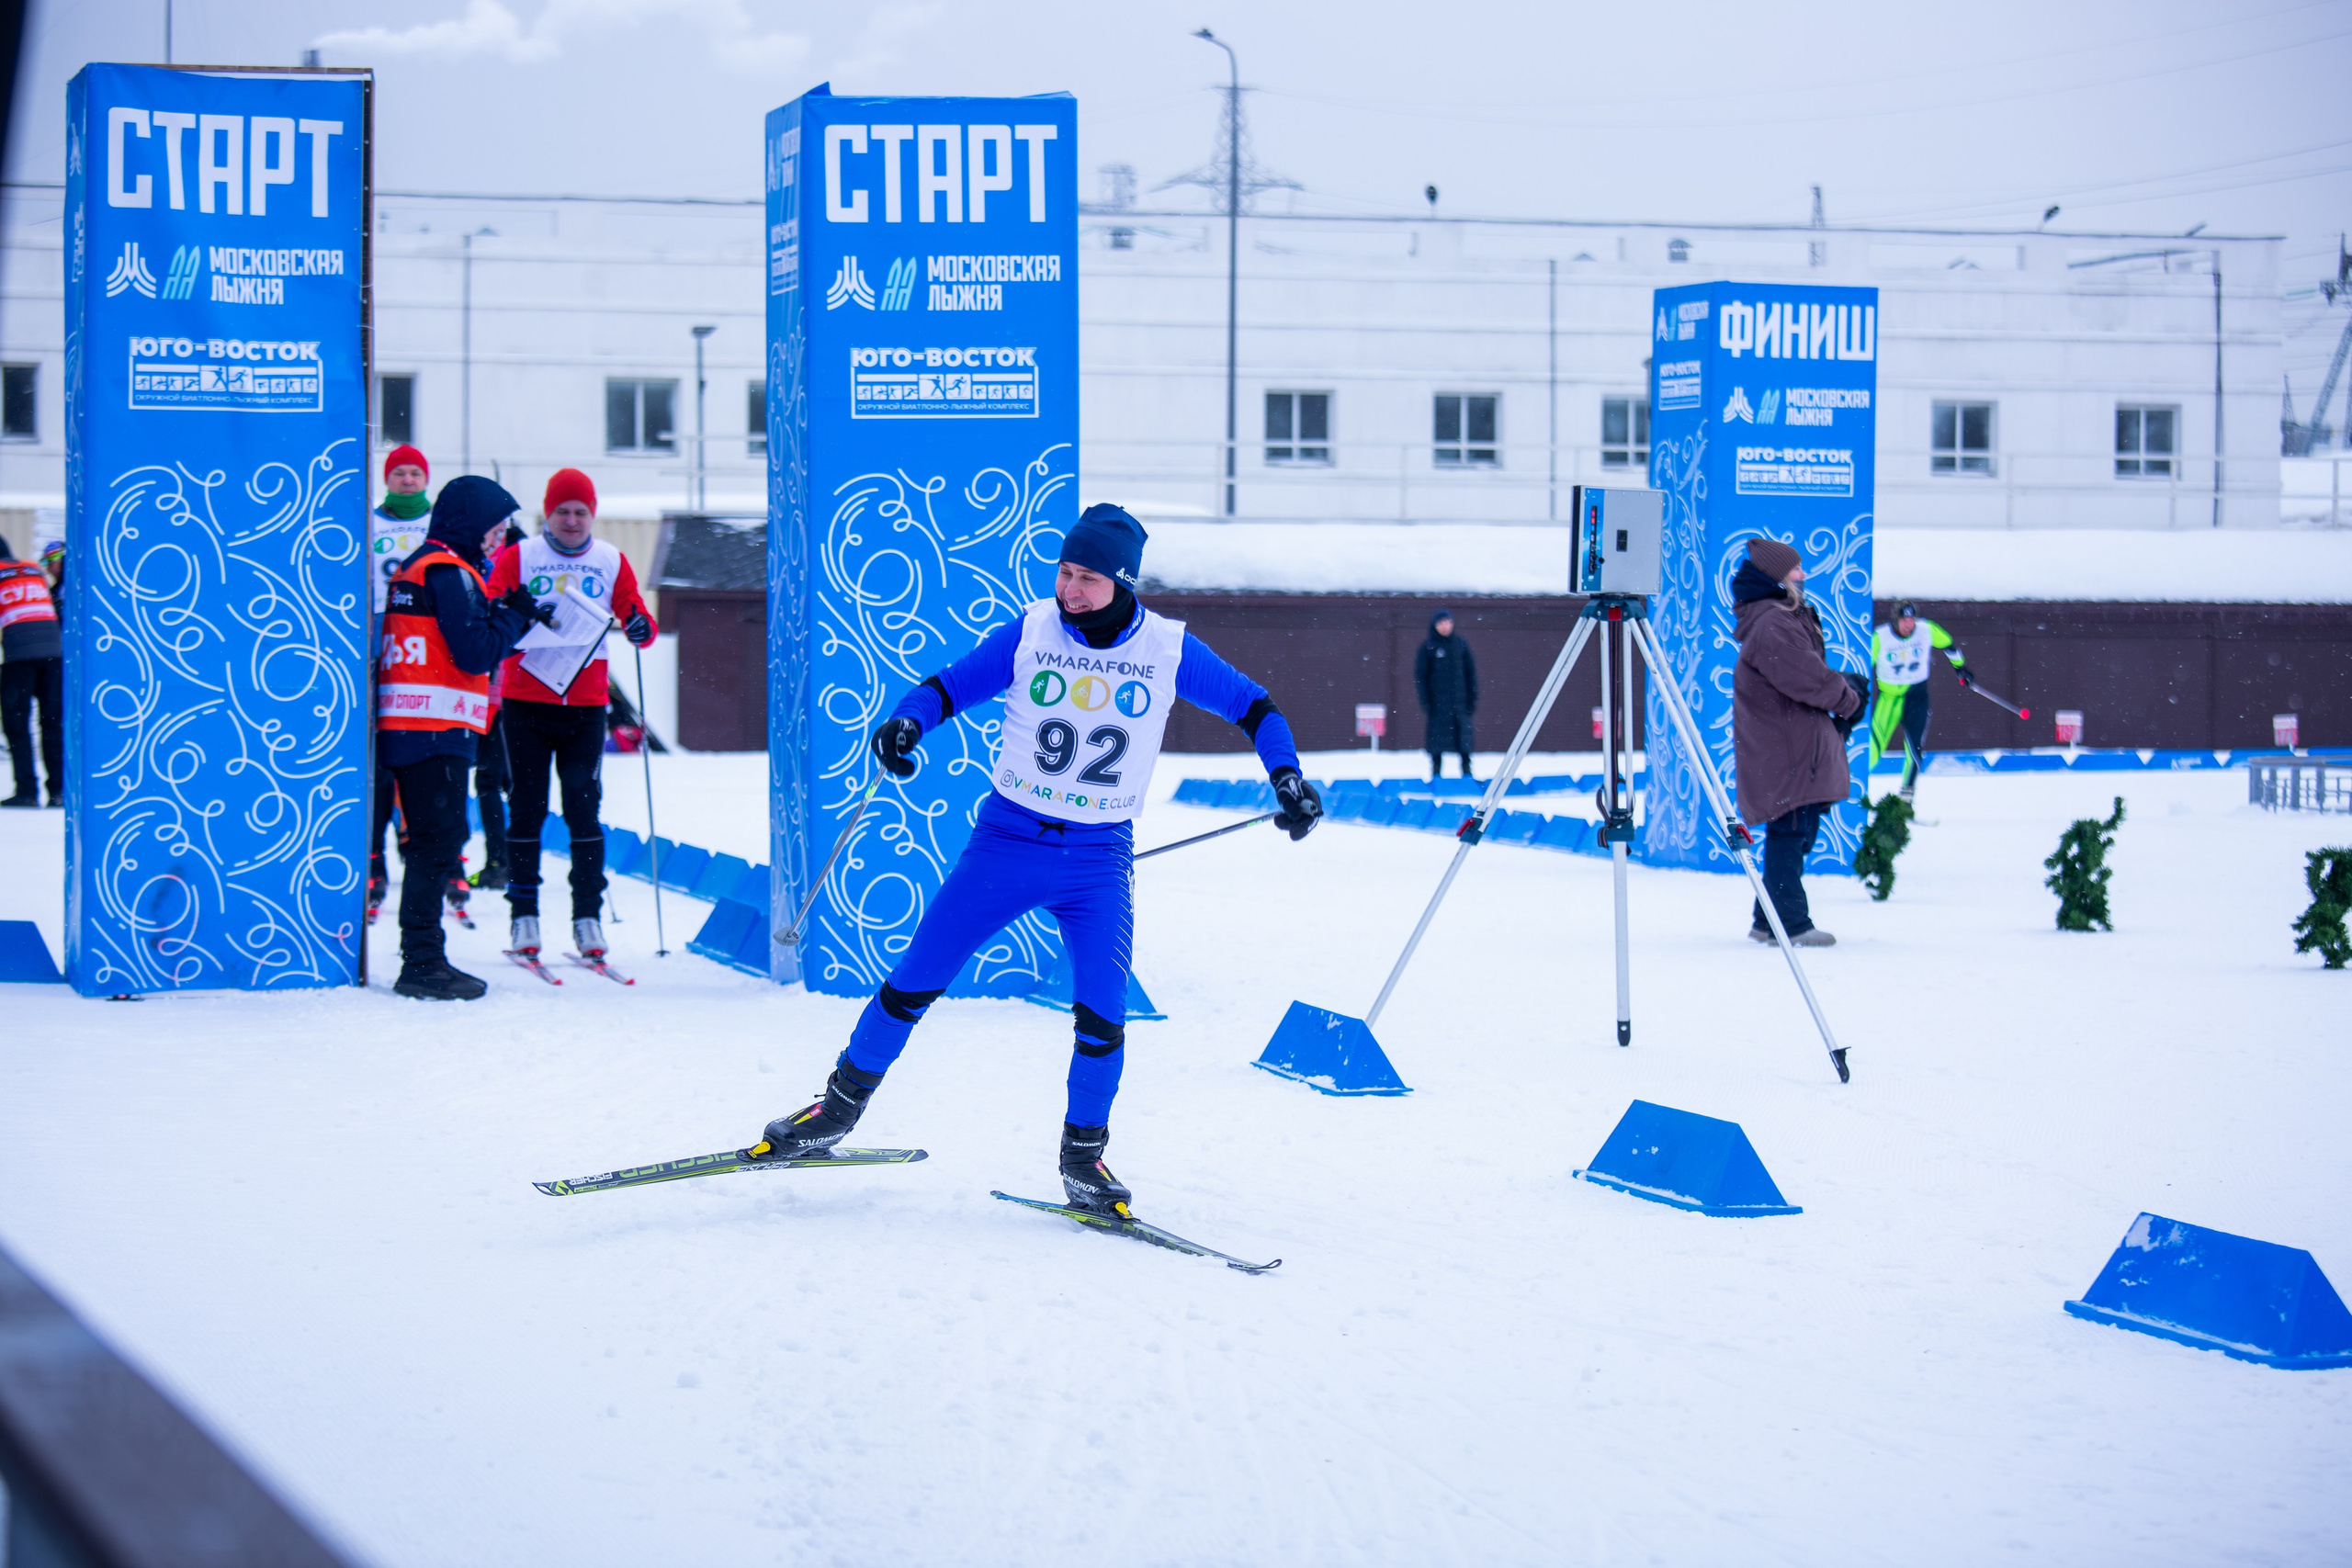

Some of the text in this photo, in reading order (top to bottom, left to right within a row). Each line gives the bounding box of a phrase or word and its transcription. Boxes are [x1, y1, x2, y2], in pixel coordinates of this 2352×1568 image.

[107, 107, 344, 218] СТАРТ
[824, 124, 1057, 223] СТАРТ
[209, 246, 344, 276] МОСКОВСКАЯ
[927, 255, 1060, 282] МОСКОВСКАЯ
[209, 275, 284, 305] ЛЫЖНЯ
[927, 285, 1002, 311] ЛЫЖНЯ
[1719, 301, 1875, 361] ФИНИШ
[130, 337, 321, 361] ЮГО-ВОСТОК
[850, 347, 1037, 367] ЮГО-ВОСТОК
[135, 393, 179, 401] ОКРУЖНОЙ
[857, 402, 900, 411] ОКРУЖНОЙ
[901, 402, 986, 411] БИАТЛОННО-ЛЫЖНЫЙ
[1786, 389, 1870, 410] МОСКОВСКАЯ
[1785, 407, 1833, 427] ЛЫЖНЯ
[1736, 446, 1853, 463] ЮГО-ВОСТОК
[530, 563, 603, 577] VMARAFONE
[1035, 651, 1156, 680] VMARAFONE
[395, 694, 432, 711] СПОРТ
[1035, 718, 1130, 787] 92
[1013, 775, 1136, 811] VMARAFONE.CLUB
[831, 1084, 856, 1105] SALOMON
[797, 1132, 846, 1148] SALOMON
[569, 1172, 613, 1186] FISCHER
[1063, 1172, 1100, 1194] SALOMON
